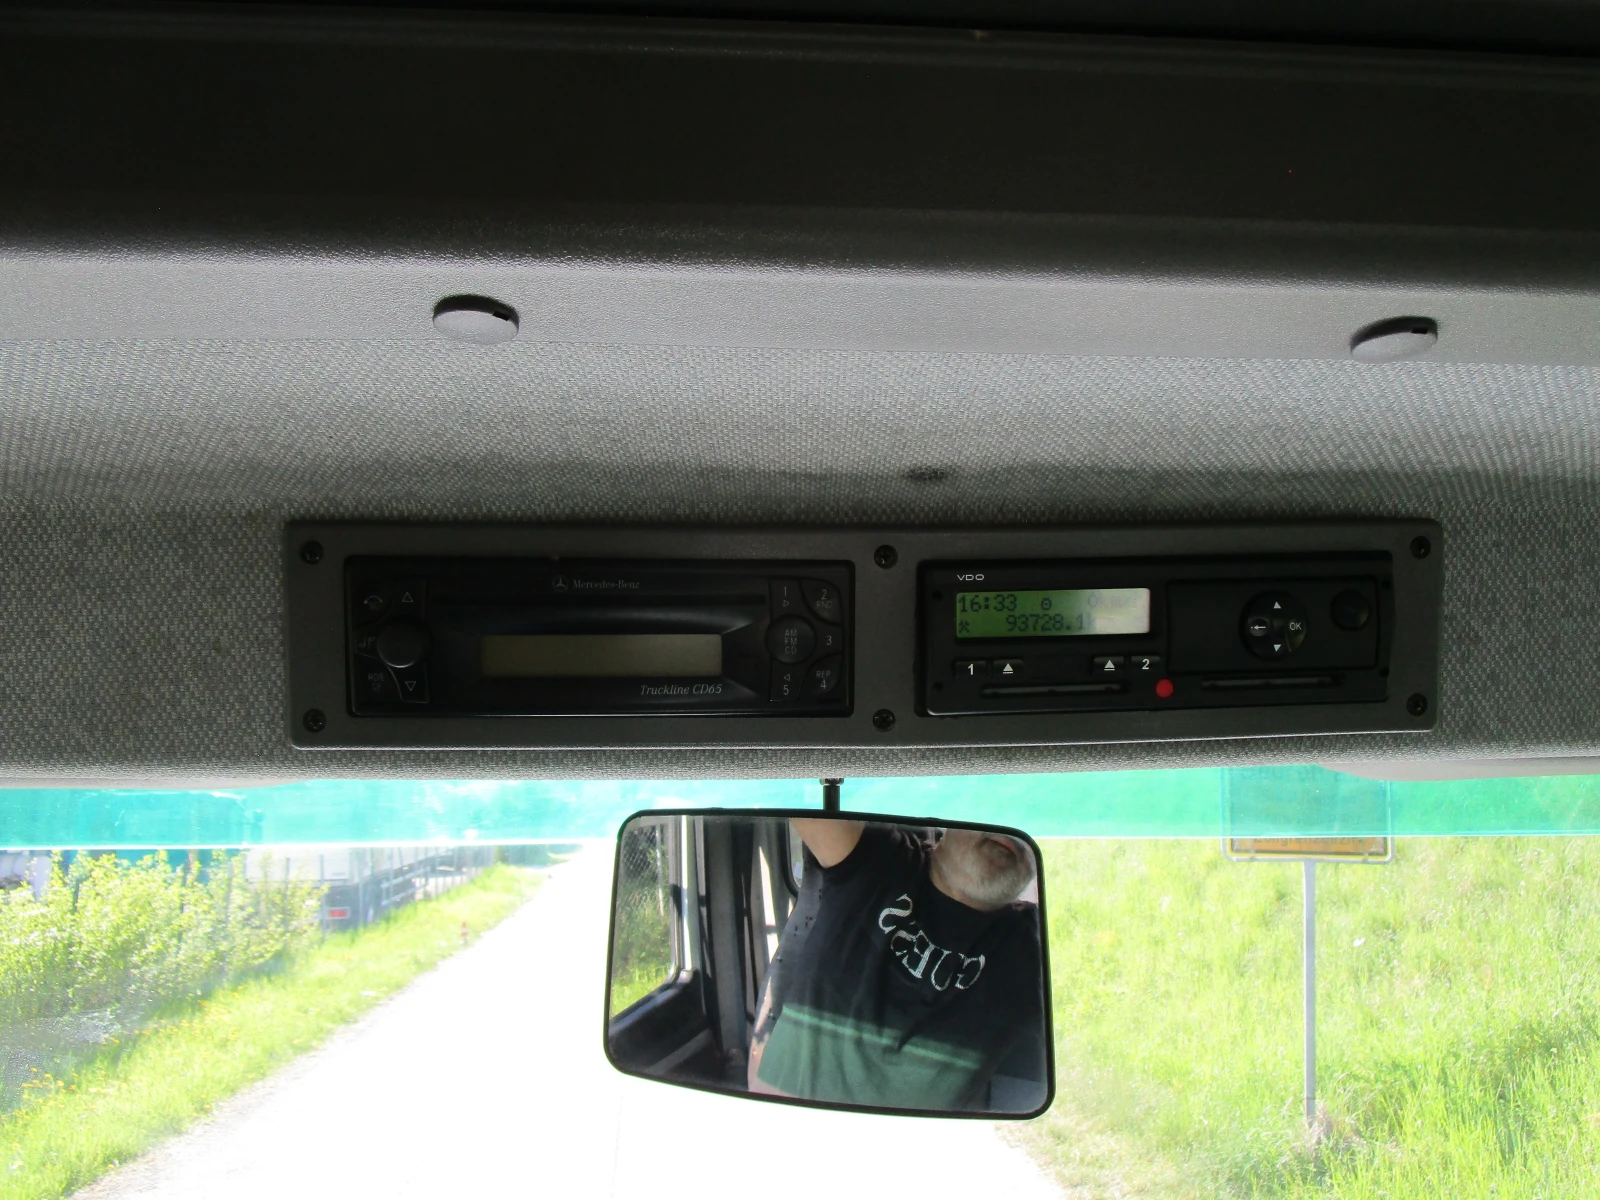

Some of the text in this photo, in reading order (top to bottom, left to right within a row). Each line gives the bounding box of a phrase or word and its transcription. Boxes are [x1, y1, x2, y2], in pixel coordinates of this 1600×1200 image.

[956, 573, 985, 582] VDO
[572, 579, 640, 590] Mercedes-Benz
[782, 586, 788, 597] 1
[821, 588, 828, 600] 2
[816, 600, 833, 609] RND
[958, 594, 1018, 612] 16:33
[1289, 622, 1302, 631] OK
[784, 629, 798, 637] AM
[784, 637, 798, 645] FM
[826, 635, 832, 646] 3
[784, 646, 797, 655] CD
[967, 663, 974, 676] 1
[1141, 658, 1150, 670] 2
[816, 670, 831, 679] REP
[640, 683, 723, 696] Truckline CD65
[783, 684, 790, 696] 5
[820, 679, 827, 690] 4
